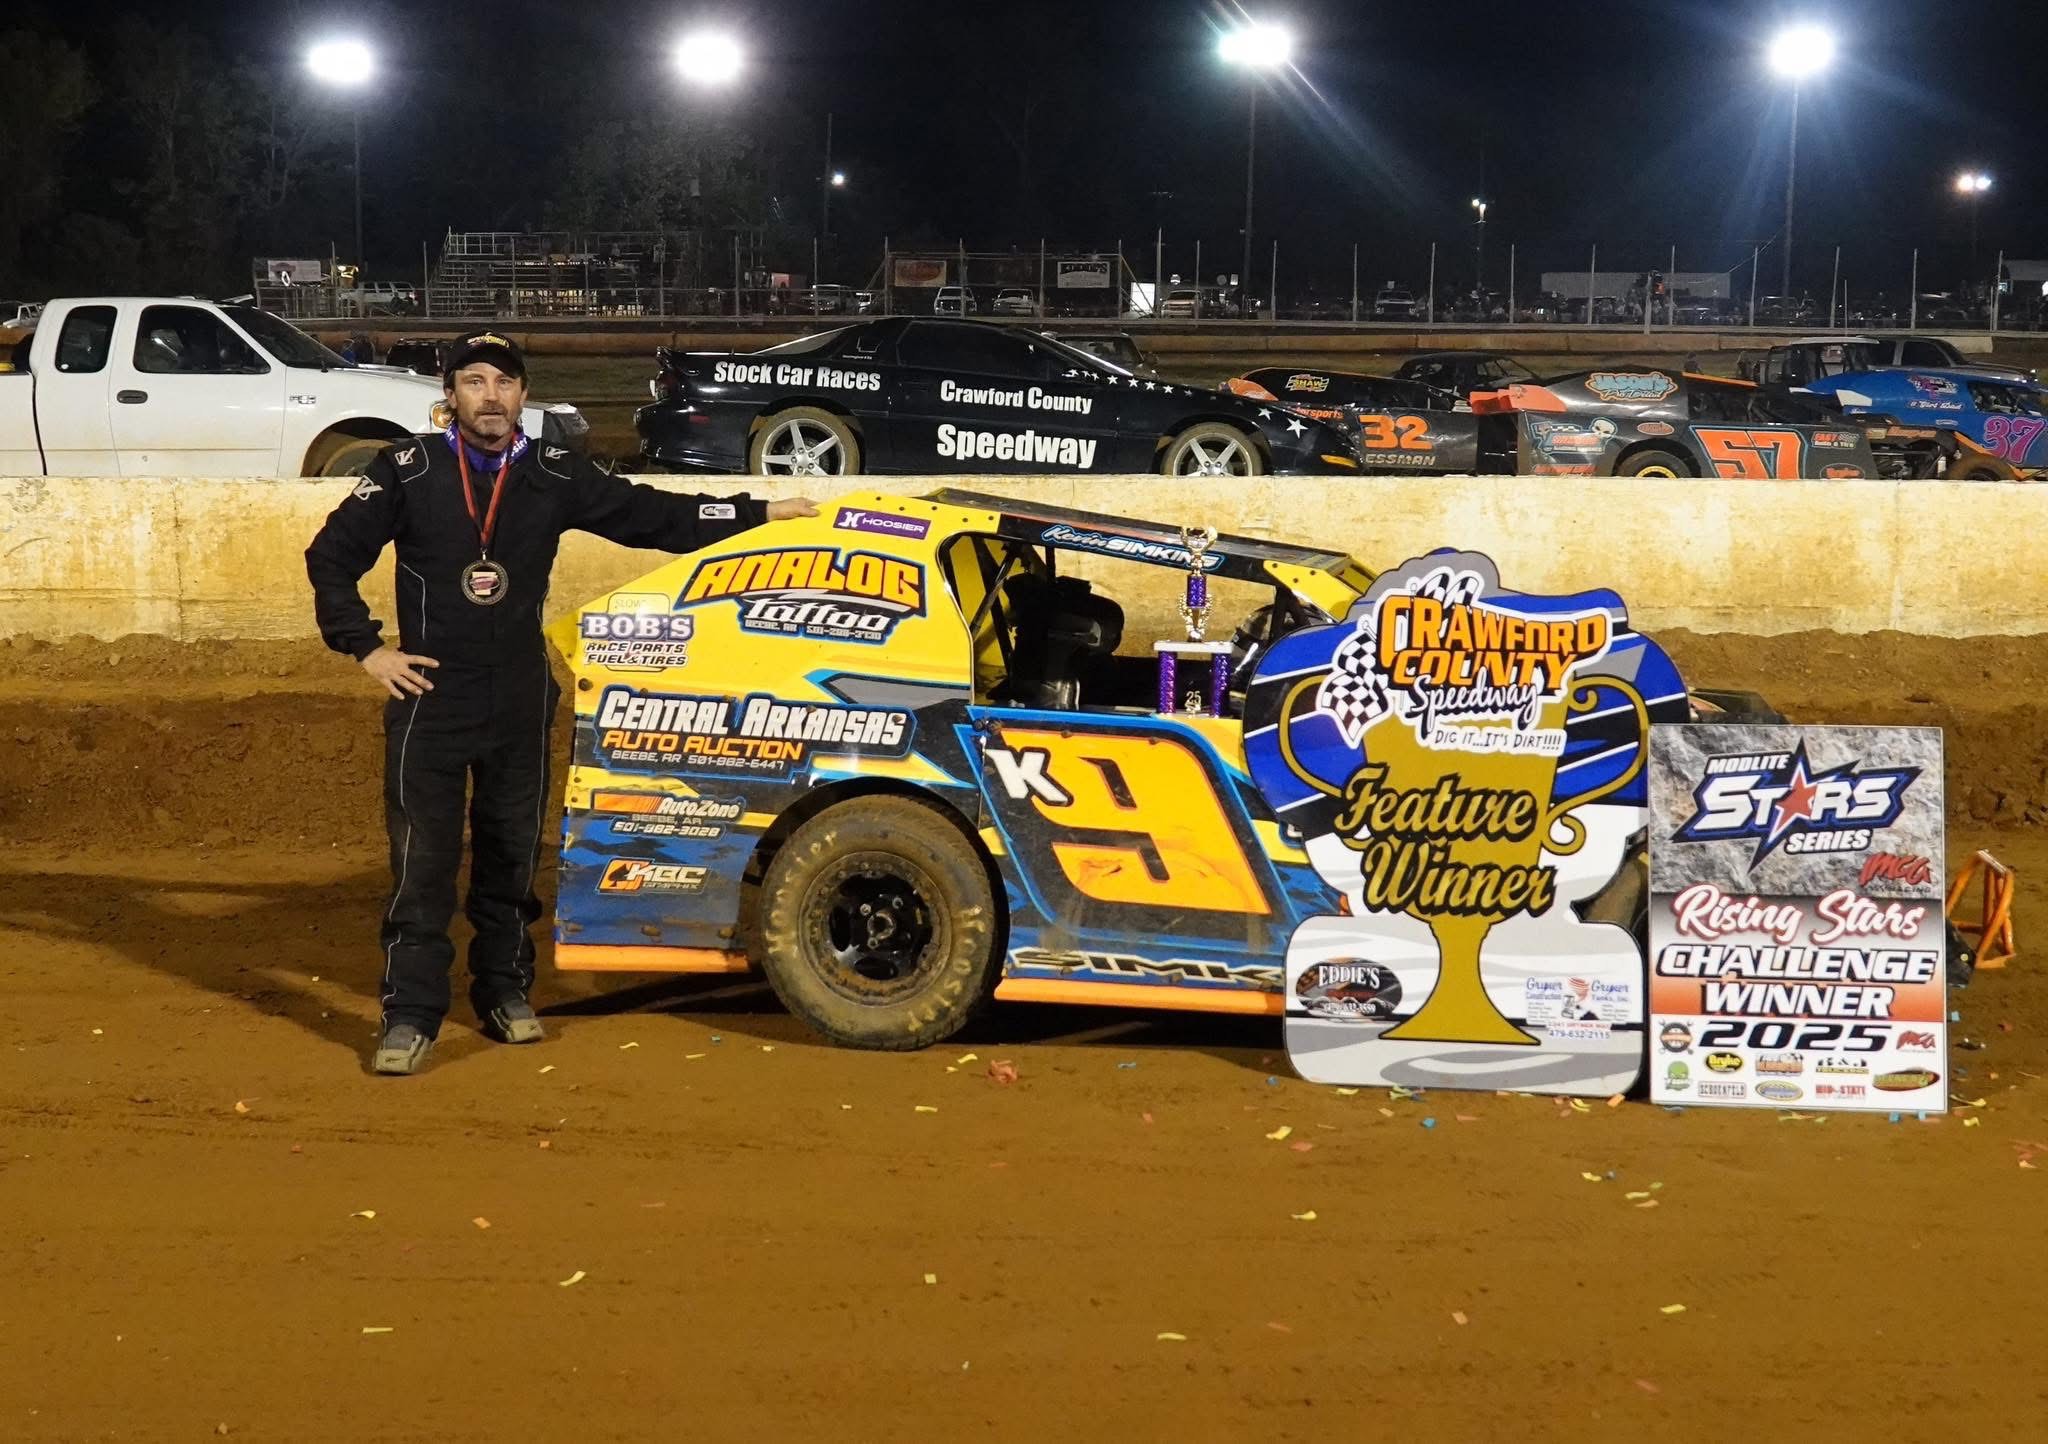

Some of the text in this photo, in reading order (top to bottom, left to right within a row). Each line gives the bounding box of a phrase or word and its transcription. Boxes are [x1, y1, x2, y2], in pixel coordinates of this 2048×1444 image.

[714, 361, 881, 391] Stock Car Races
[940, 379, 1093, 415] Crawford County
[936, 423, 1097, 469] Speedway
[1359, 414, 1433, 450] 32
[1984, 416, 2046, 465] 37
[1695, 429, 1801, 480] 57
[862, 517, 925, 533] HOOSIER
[1044, 527, 1107, 548] Kevin
[683, 551, 922, 608] ANALOG
[584, 615, 692, 639] BOB'S
[1380, 595, 1607, 668] CRAWFORD
[586, 642, 685, 653] RACE PARTS
[1394, 650, 1576, 688] COUNTY
[599, 690, 905, 747] CENTRAL ARKANSAS
[1184, 690, 1202, 711] 25
[1409, 667, 1538, 736] Speedway
[602, 730, 805, 761] AUTO AUCTION
[1435, 729, 1458, 745] DIG
[611, 750, 659, 763] BEEBE,
[661, 753, 682, 764] AR
[1707, 754, 1791, 775] MODLITE
[656, 797, 740, 819] AutoZone
[1335, 764, 1537, 838] Feature
[987, 728, 1271, 915] K 9
[1786, 829, 1872, 852] SERIES
[1364, 838, 1555, 914] Winner
[1673, 884, 1926, 945] Rising Stars
[1318, 965, 1381, 990] EDDIE'S
[1656, 944, 1938, 983] CHALLENGE
[1702, 982, 1895, 1018] WINNER
[1698, 1020, 1893, 1051] 2025
